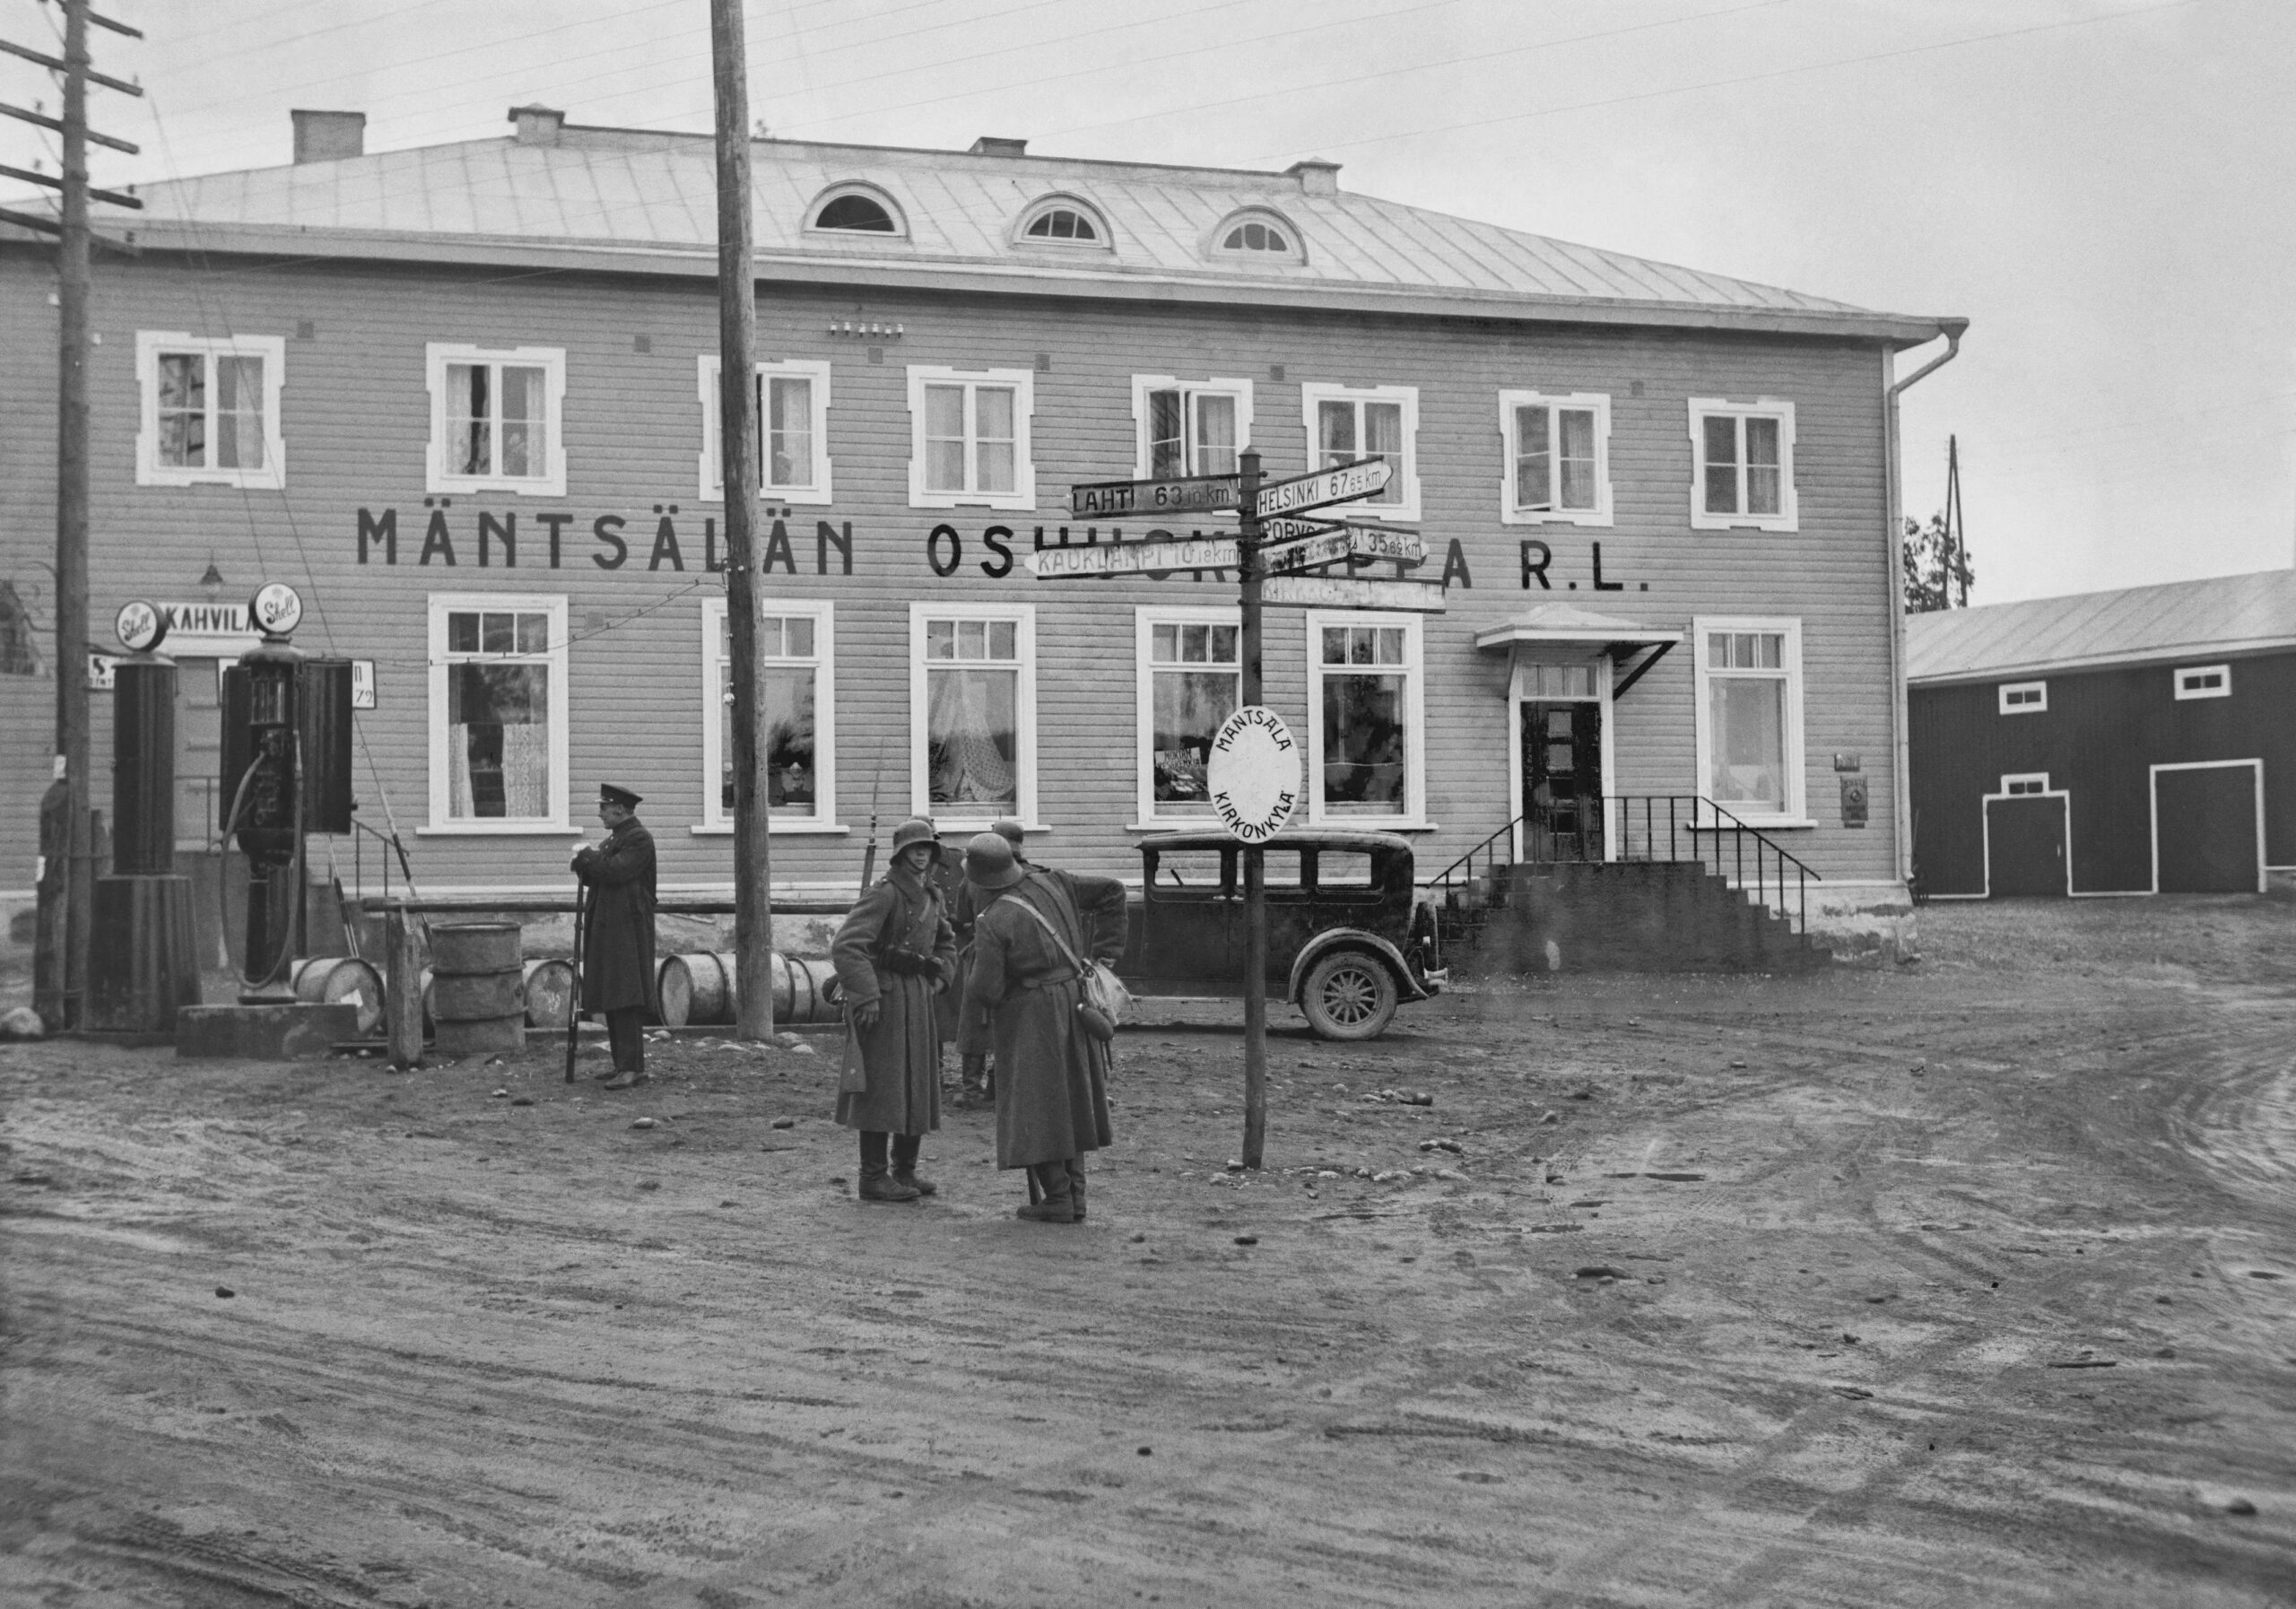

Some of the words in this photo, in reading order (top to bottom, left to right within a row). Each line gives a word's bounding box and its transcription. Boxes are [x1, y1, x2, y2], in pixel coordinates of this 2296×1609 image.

[1072, 488, 1135, 513] LAHTI
[1258, 480, 1319, 516] HELSINKI
[1365, 466, 1382, 489] km
[357, 497, 852, 576] MÄNTSÄLÄN
[1520, 539, 1648, 591] R.L.
[1037, 548, 1161, 572] KAUKLAMPI
[121, 611, 152, 641] Shell
[264, 595, 296, 625] Shell
[1215, 709, 1292, 752] MÄNTSÄLÄ
[1213, 789, 1295, 839] KIRKONKYLÄ
